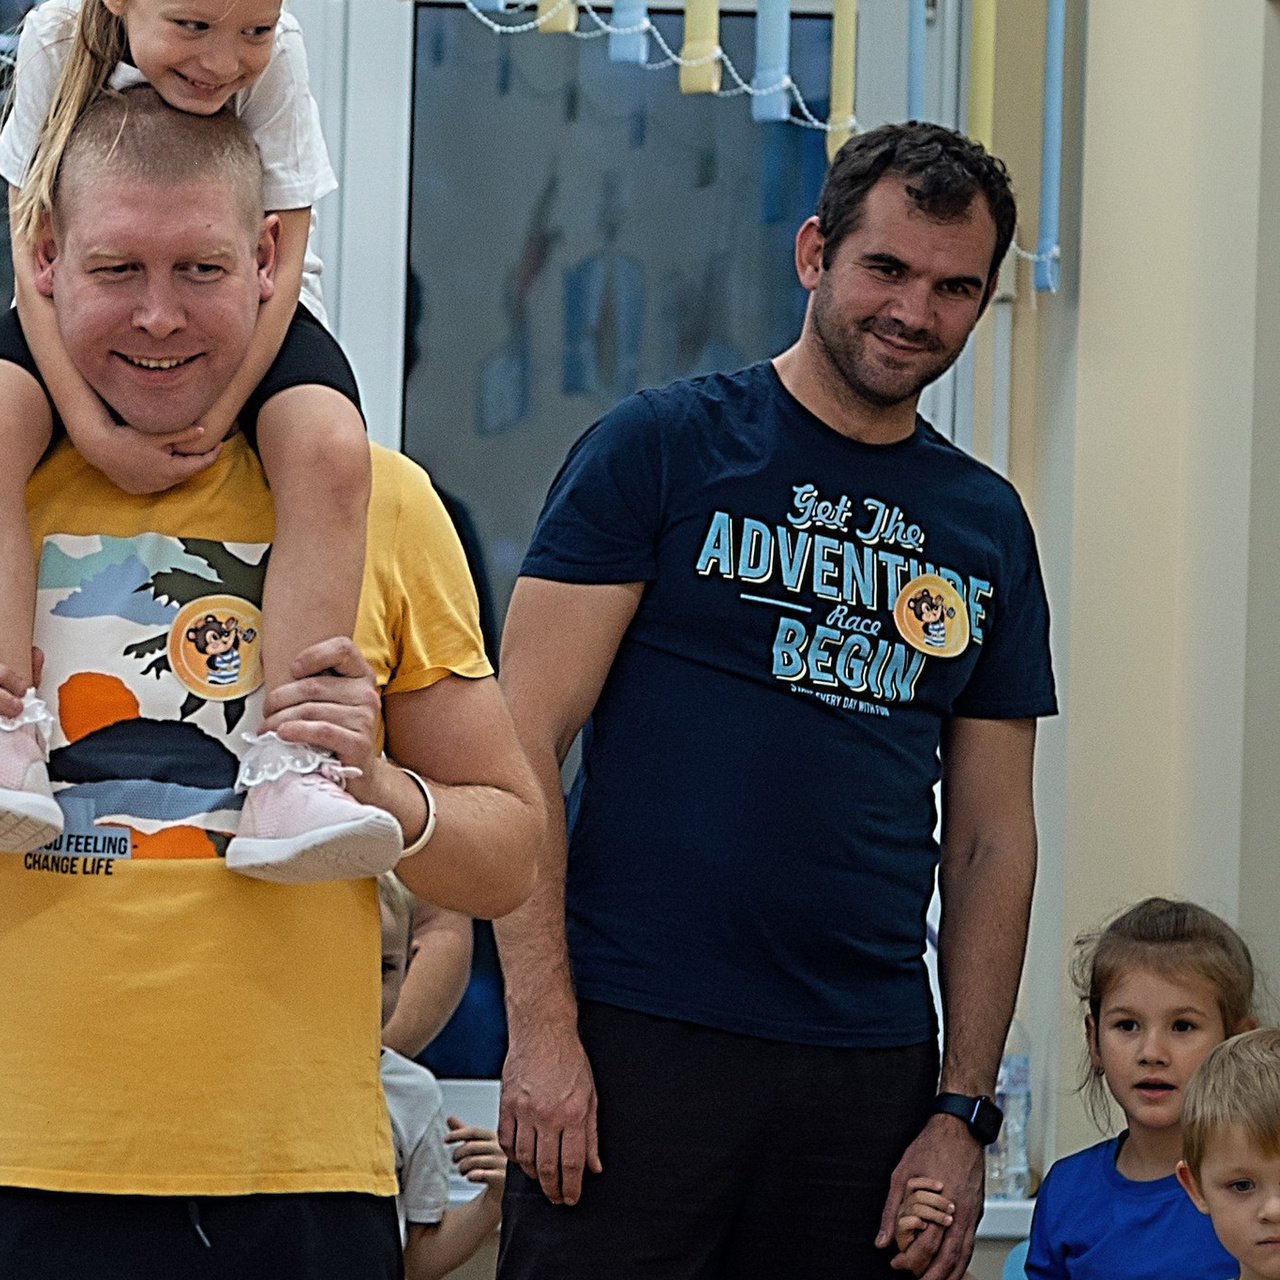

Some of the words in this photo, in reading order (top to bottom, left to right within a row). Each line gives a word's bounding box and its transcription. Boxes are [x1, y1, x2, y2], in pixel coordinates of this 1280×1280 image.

[786, 483, 852, 532] Get
[855, 497, 925, 553] The
[825, 604, 882, 637] Race
[772, 616, 926, 703] BEGIN
[842, 696, 858, 711] DAY
[66, 834, 128, 855] FEELING
[24, 852, 79, 875] CHANGE
[82, 858, 115, 876] LIFE
